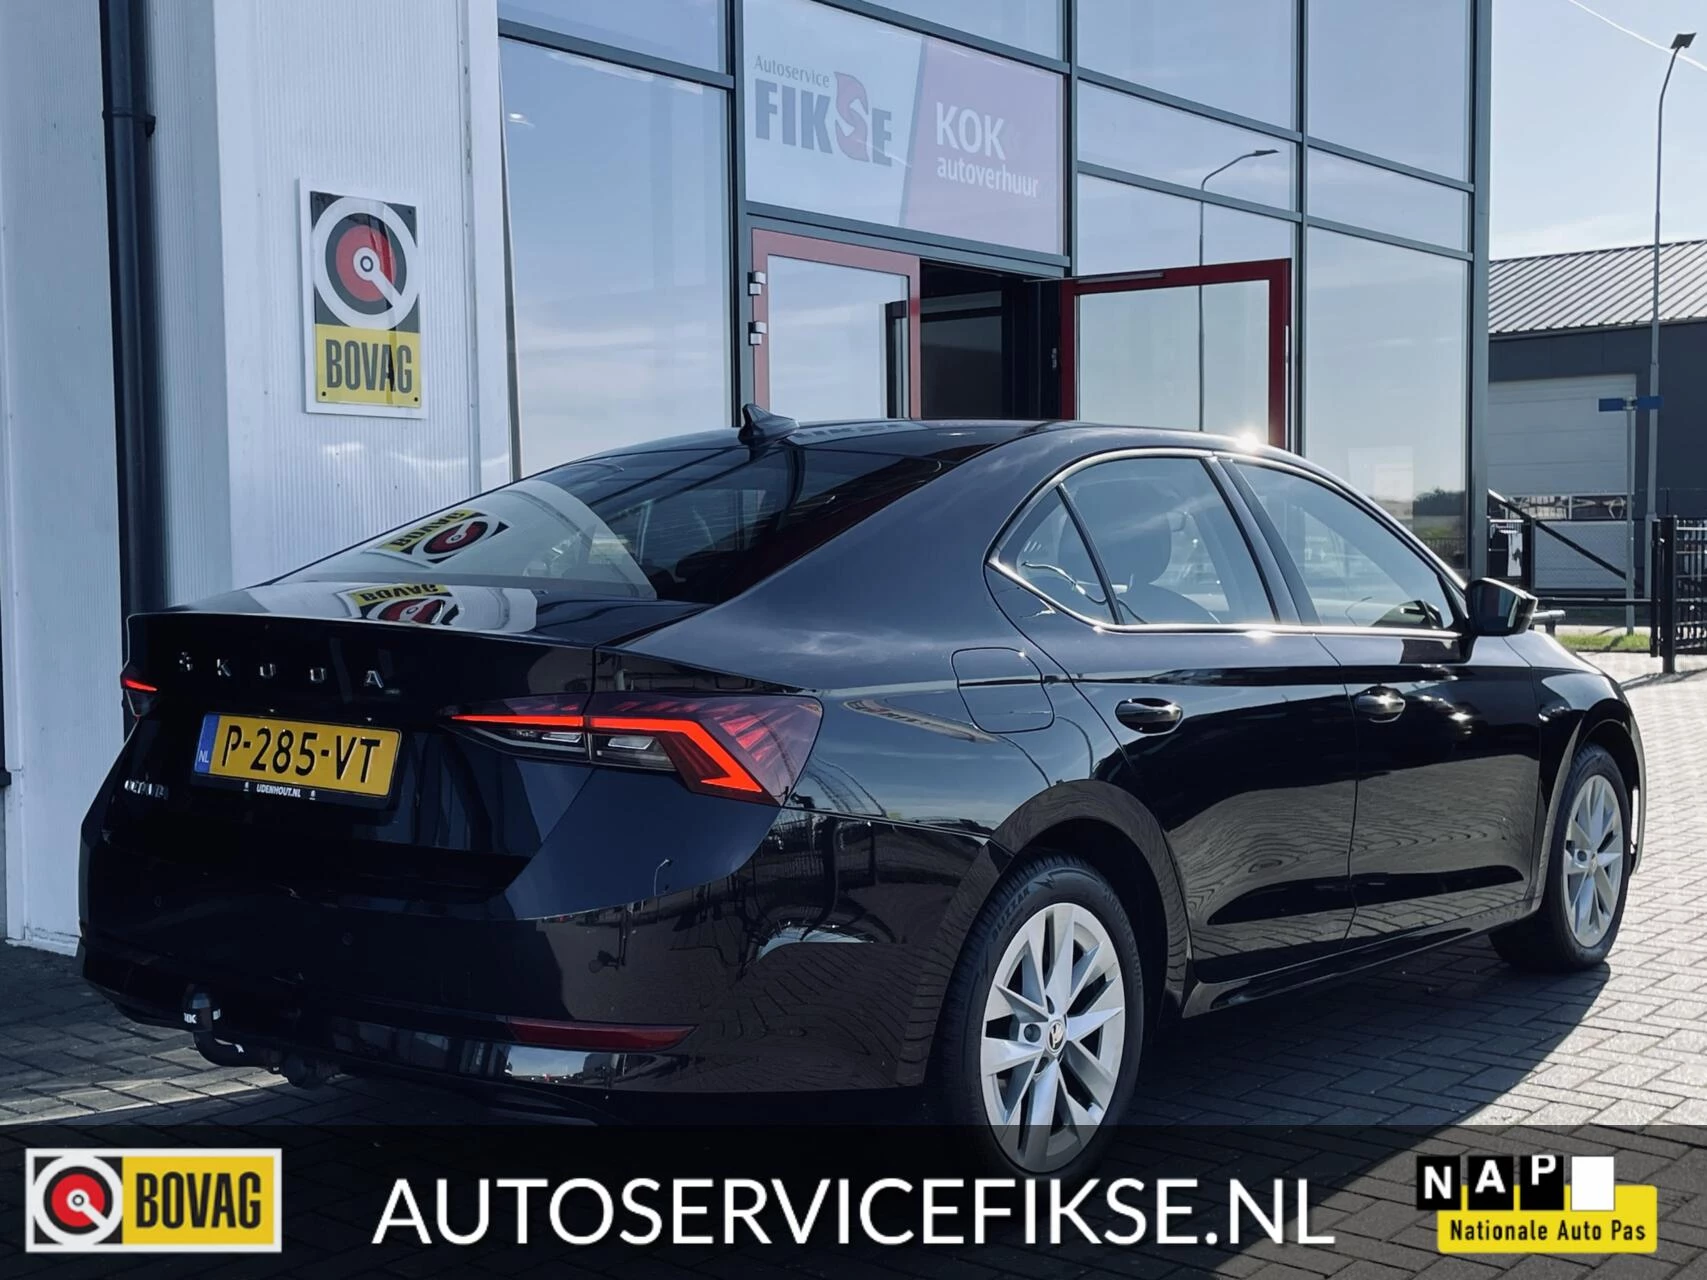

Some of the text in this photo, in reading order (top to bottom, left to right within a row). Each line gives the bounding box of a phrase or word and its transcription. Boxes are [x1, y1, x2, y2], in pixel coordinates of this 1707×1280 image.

[754, 55, 830, 88] Autoservice
[754, 71, 892, 167] FIKSE
[936, 102, 1006, 160] KOK
[937, 155, 1039, 198] autoverhuur
[325, 338, 413, 394] BOVAG
[198, 749, 210, 763] NL
[221, 725, 381, 783] P-285-VT
[256, 783, 301, 798] UDENHOUT.NL
